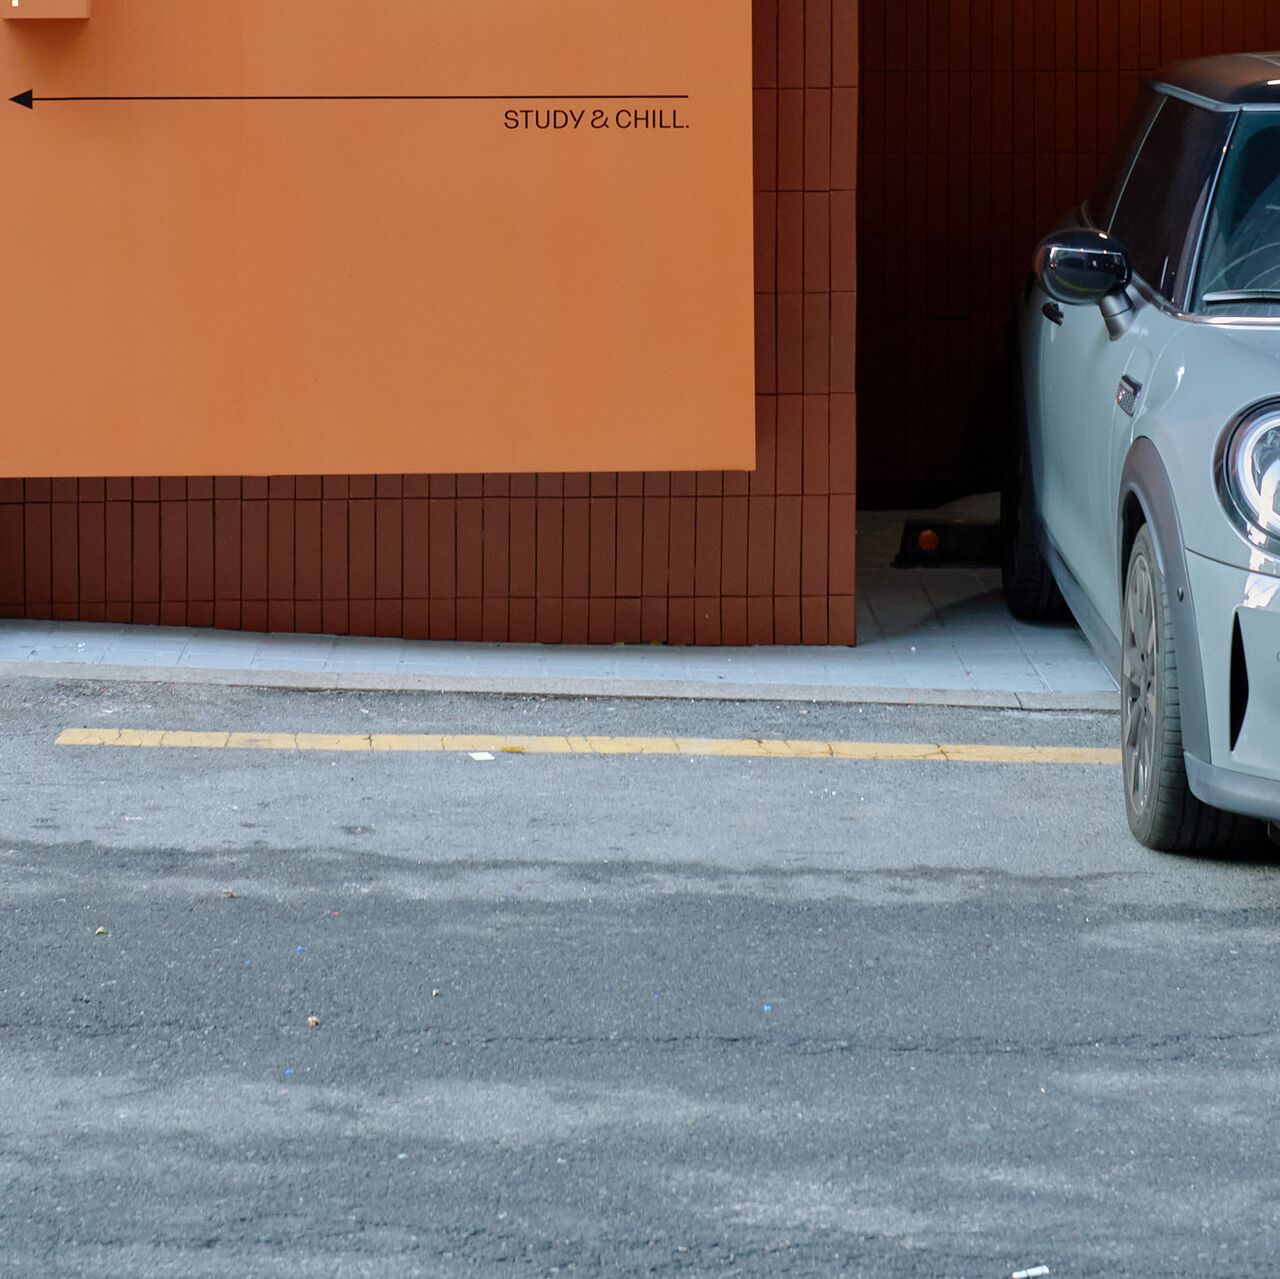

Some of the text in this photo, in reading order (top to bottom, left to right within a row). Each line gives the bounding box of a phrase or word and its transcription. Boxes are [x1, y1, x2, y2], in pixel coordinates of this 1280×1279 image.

[505, 110, 689, 129] STUDY & CHILL.
